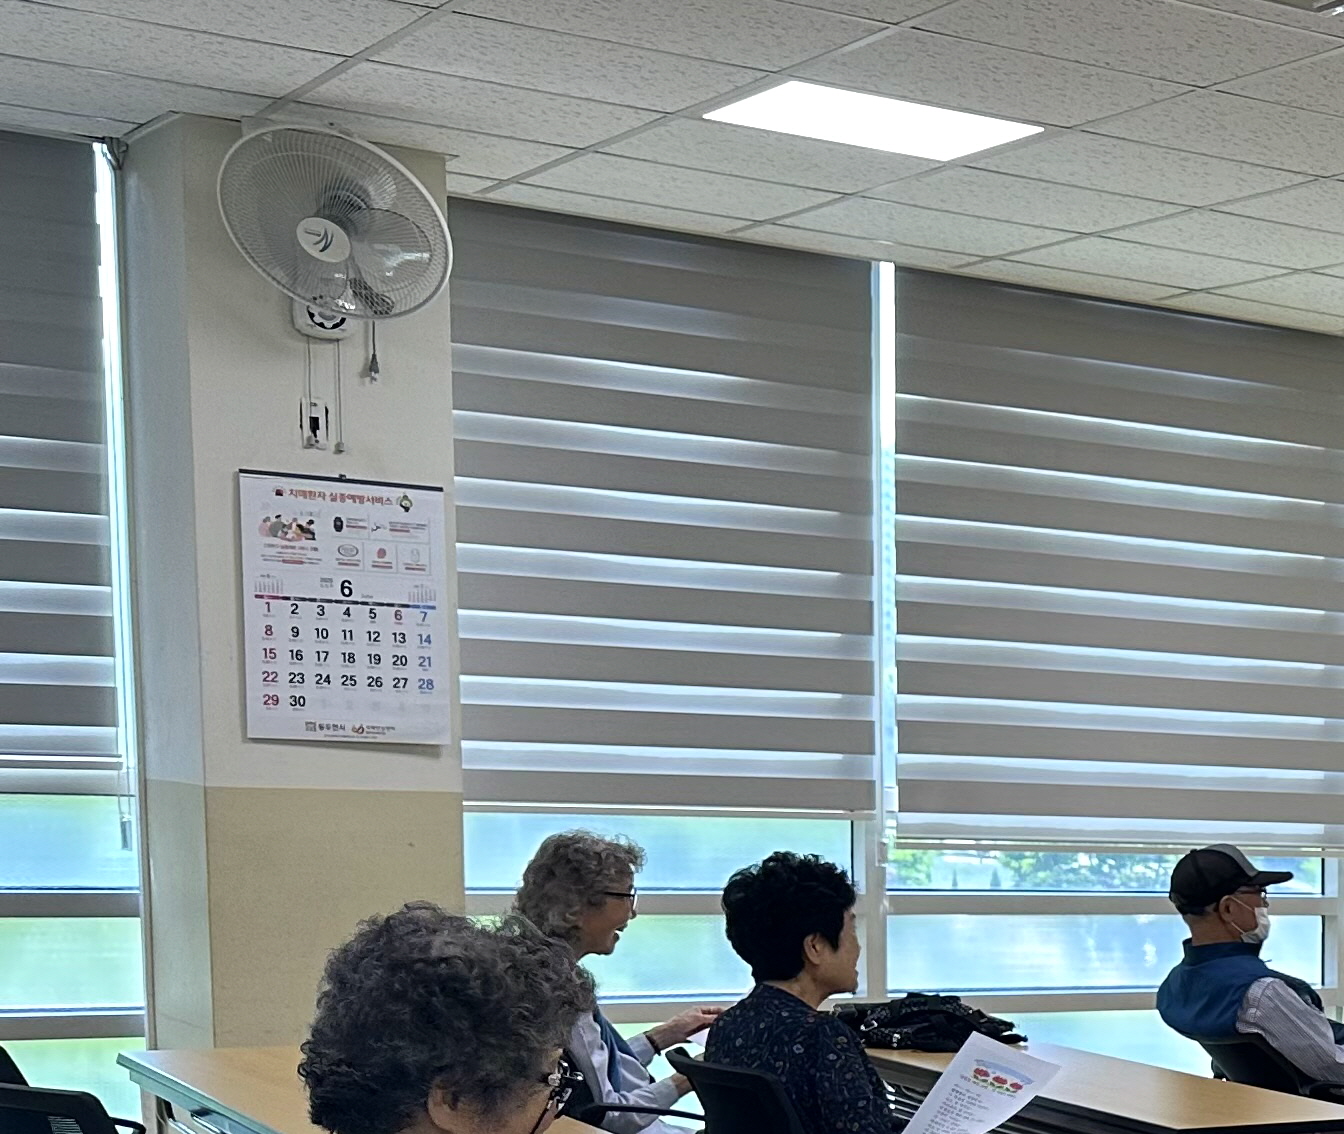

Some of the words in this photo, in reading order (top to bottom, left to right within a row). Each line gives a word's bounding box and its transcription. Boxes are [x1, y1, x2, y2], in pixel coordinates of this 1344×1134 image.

[288, 489, 326, 501] 치매환자
[329, 492, 393, 506] 실종예방서비스
[340, 579, 353, 598] 6
[265, 602, 270, 612] 1
[291, 603, 299, 614] 2
[317, 605, 325, 616] 3
[343, 607, 351, 617] 4
[369, 608, 376, 619] 5
[395, 610, 402, 621] 6
[420, 611, 427, 622] 7
[265, 625, 273, 636] 8
[291, 627, 299, 637] 9
[315, 628, 328, 639] 10
[342, 630, 353, 641] 11
[367, 631, 380, 642] 12
[392, 632, 406, 643] 13
[418, 634, 431, 644] 14
[263, 648, 276, 659] 15
[289, 650, 303, 661] 16
[316, 651, 329, 662] 17
[341, 652, 355, 663] 18
[368, 654, 381, 665] 19
[392, 655, 407, 666] 20
[419, 656, 431, 667] 21
[262, 671, 278, 682] 22
[289, 672, 304, 684] 23
[315, 674, 331, 685] 24
[341, 675, 356, 686] 25
[367, 676, 383, 687] 26
[393, 677, 408, 688] 27
[418, 679, 434, 690] 28
[263, 694, 279, 705] 29
[290, 695, 305, 707] 30
